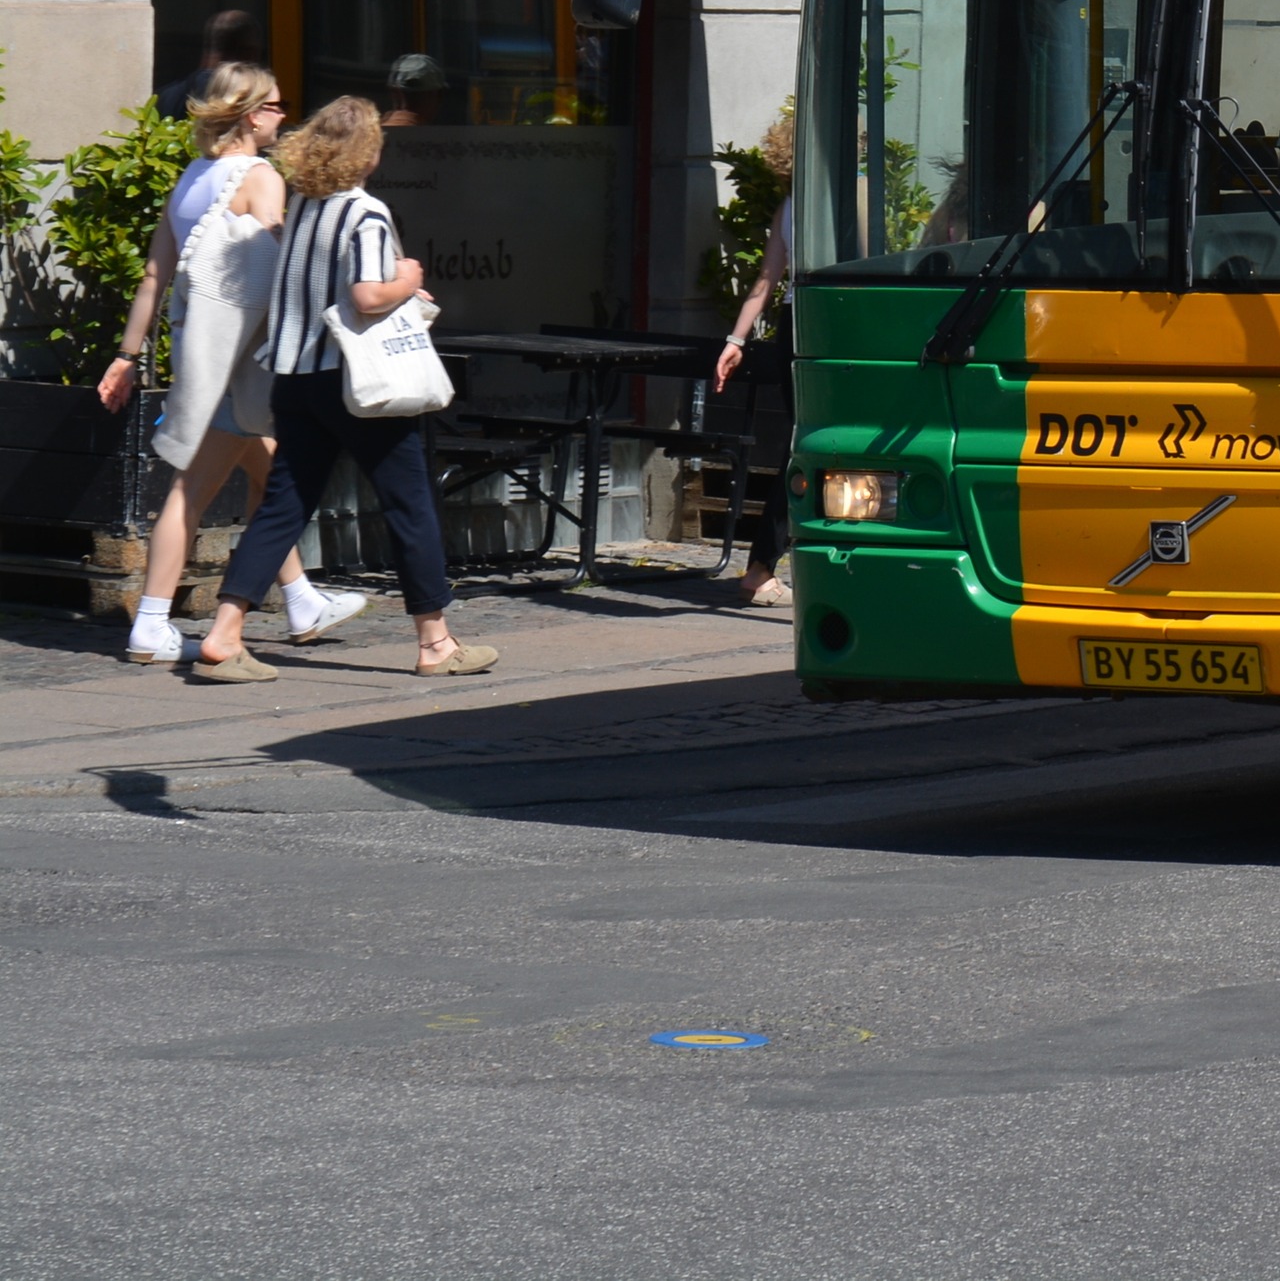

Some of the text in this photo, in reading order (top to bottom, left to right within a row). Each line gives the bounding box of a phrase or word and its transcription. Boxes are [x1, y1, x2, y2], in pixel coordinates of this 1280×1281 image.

[425, 239, 513, 281] kebab
[1034, 413, 1126, 458] DOT
[1093, 646, 1250, 685] BY 55 654
